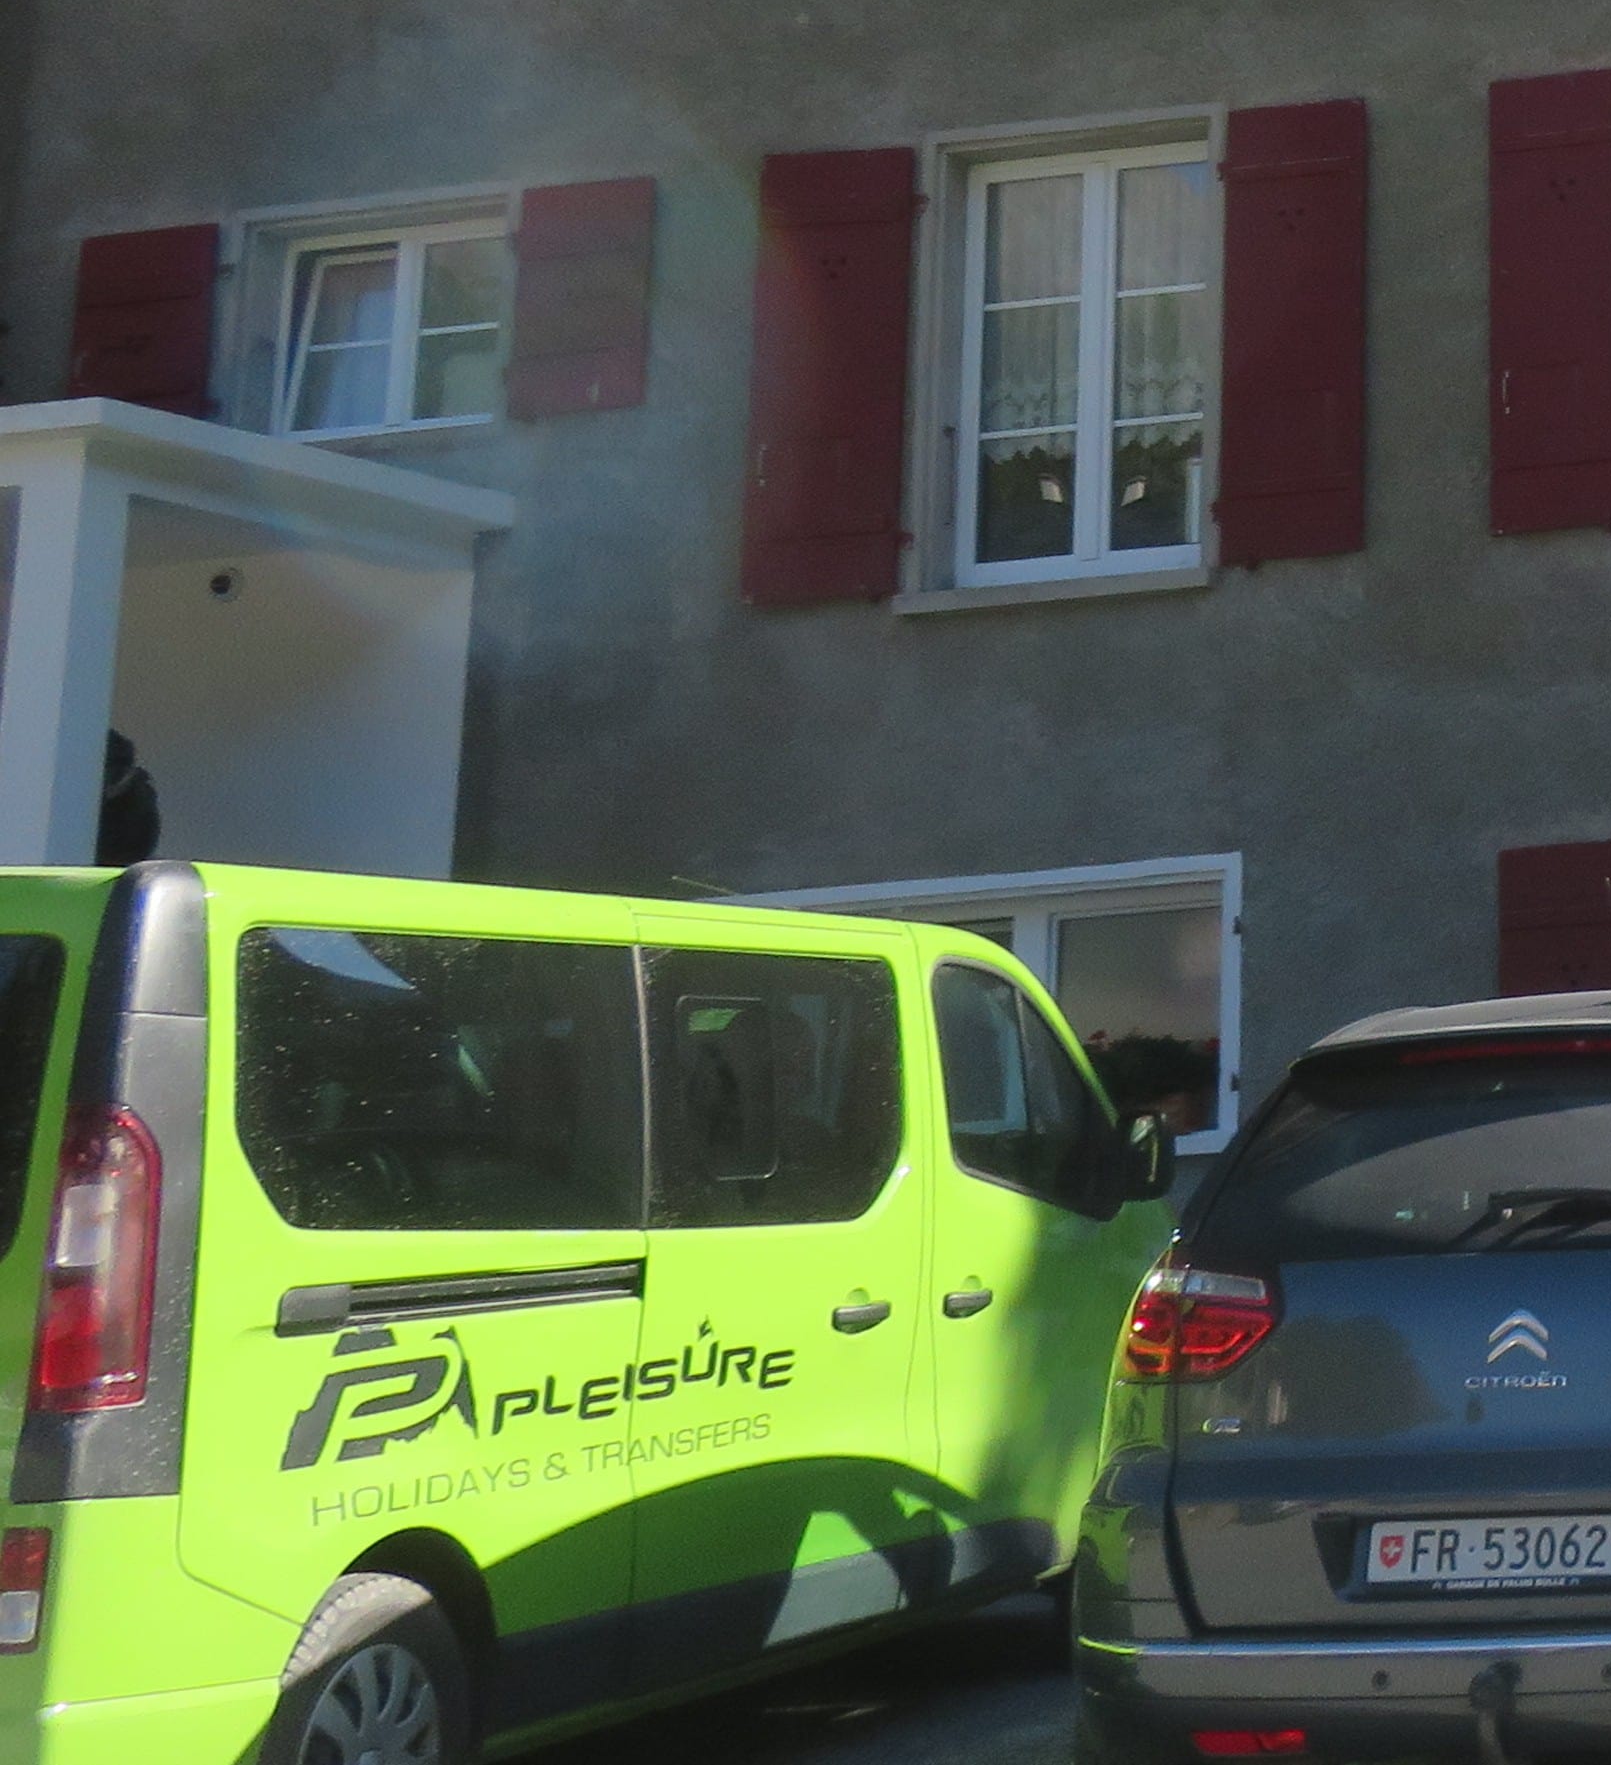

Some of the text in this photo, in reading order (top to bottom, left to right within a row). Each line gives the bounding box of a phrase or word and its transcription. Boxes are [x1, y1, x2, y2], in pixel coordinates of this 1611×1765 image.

[311, 1413, 773, 1528] HOLIDAYS & TRANSFERS
[1409, 1527, 1461, 1574] FR
[1482, 1523, 1609, 1572] 53062
